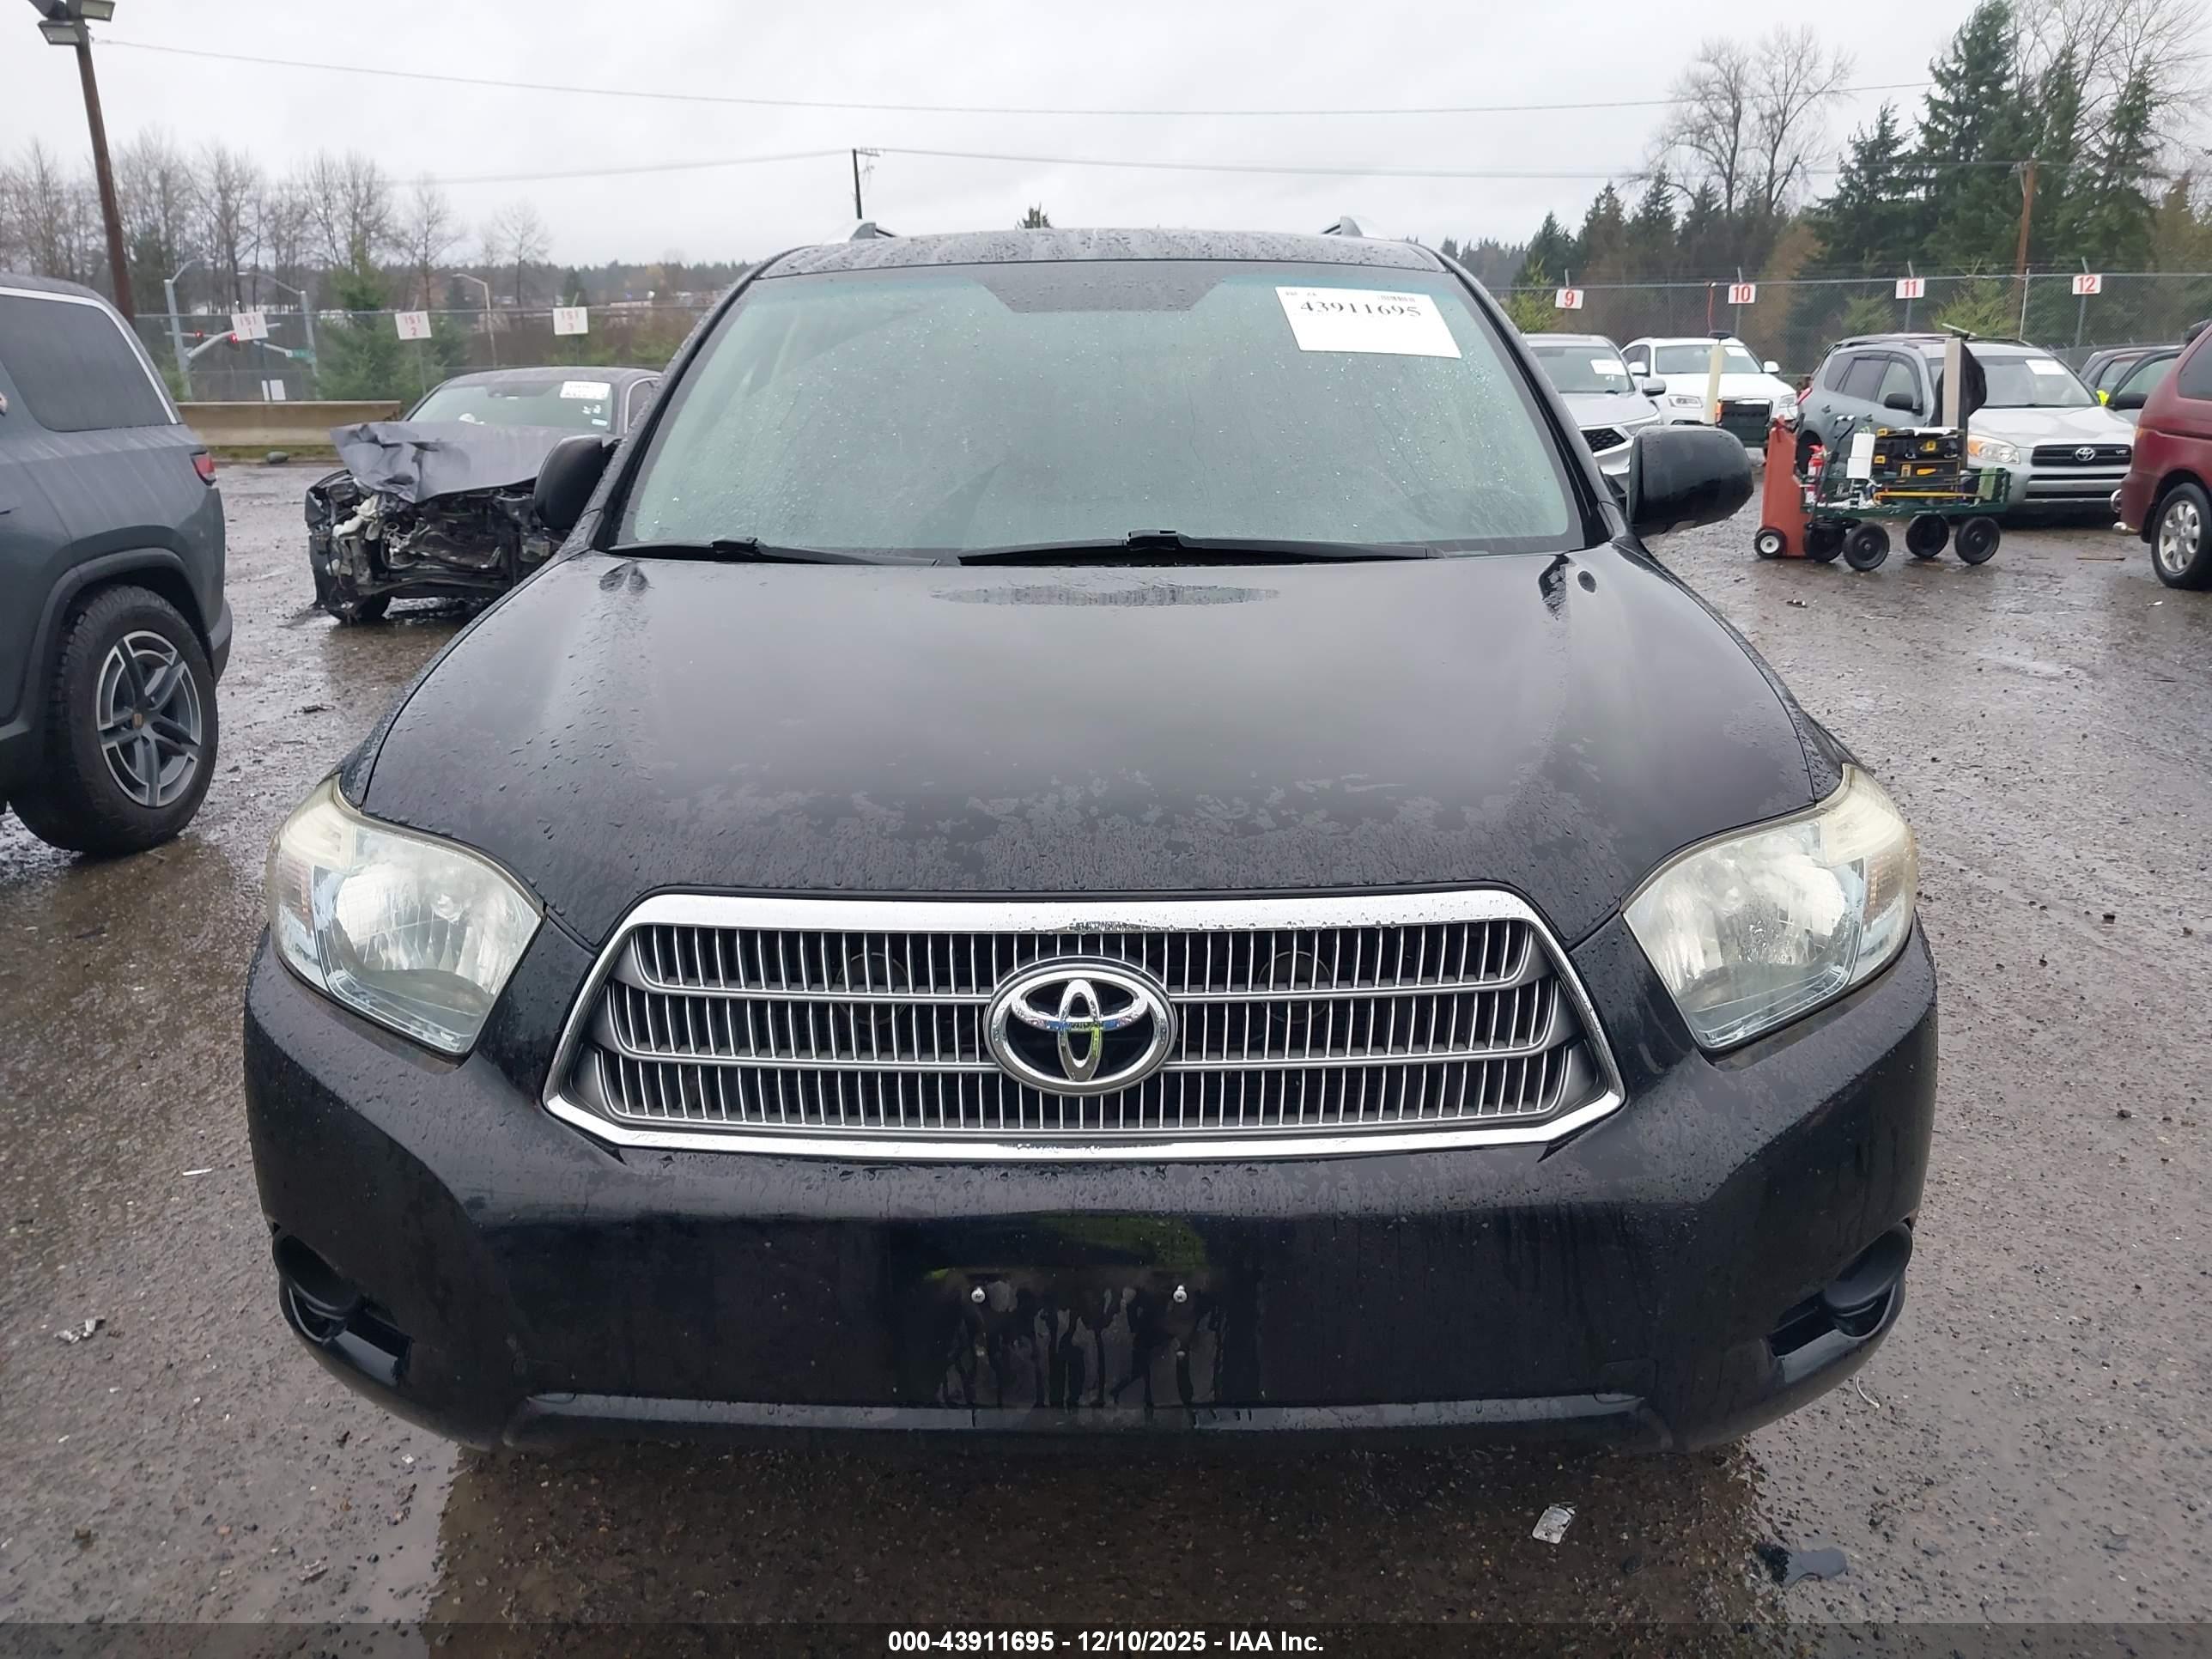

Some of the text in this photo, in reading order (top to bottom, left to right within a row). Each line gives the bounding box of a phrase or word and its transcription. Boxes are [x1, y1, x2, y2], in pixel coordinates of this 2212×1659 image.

[1903, 281, 1917, 297] 11
[2078, 276, 2096, 292] 12
[1565, 290, 1575, 307] 9
[1734, 285, 1751, 303] 10
[1300, 300, 1422, 318] 43911695
